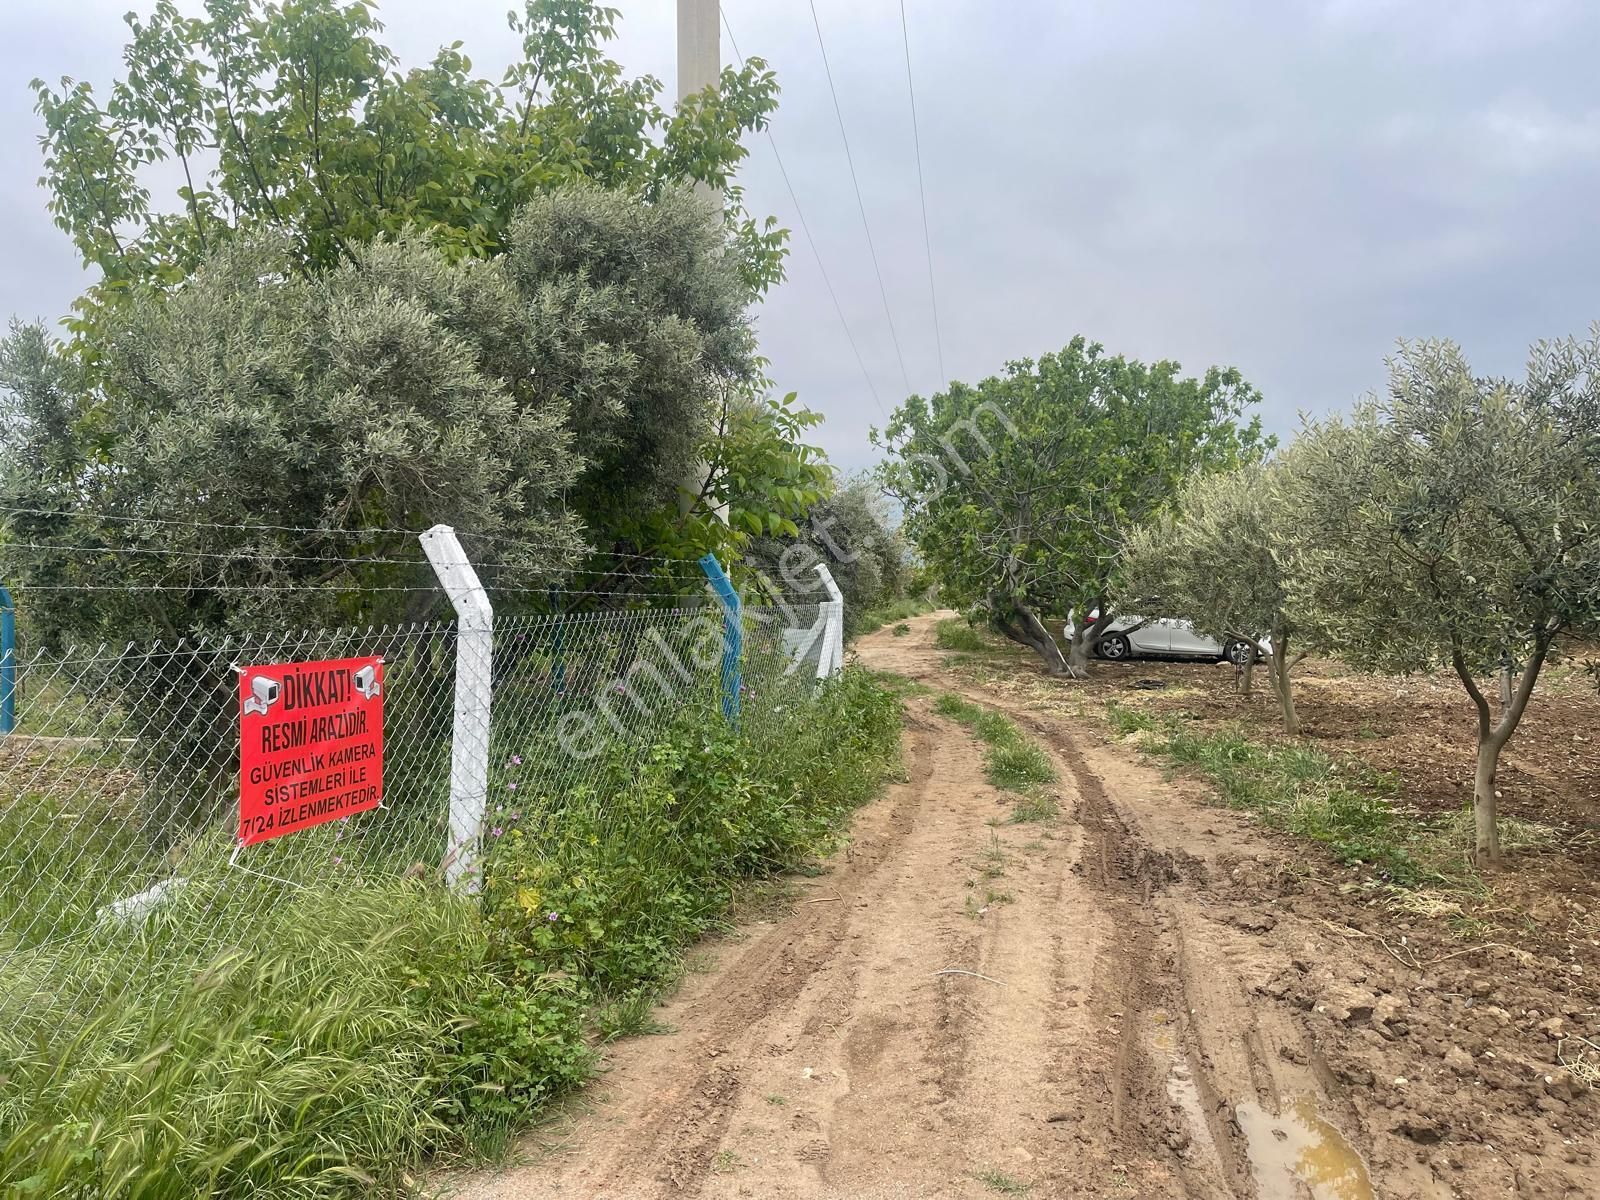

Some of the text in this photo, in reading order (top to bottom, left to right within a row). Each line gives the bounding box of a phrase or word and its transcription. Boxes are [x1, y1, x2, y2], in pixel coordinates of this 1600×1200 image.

[283, 668, 351, 710] DİKKAT!
[262, 707, 369, 753] RESMİ ARAZİDİR.
[250, 742, 376, 784] GÜVENLİK KAMERA
[264, 767, 367, 806] SİSTEMLERİ İLE
[243, 783, 380, 836] 7/24 İZLENMEKTEDİR.
